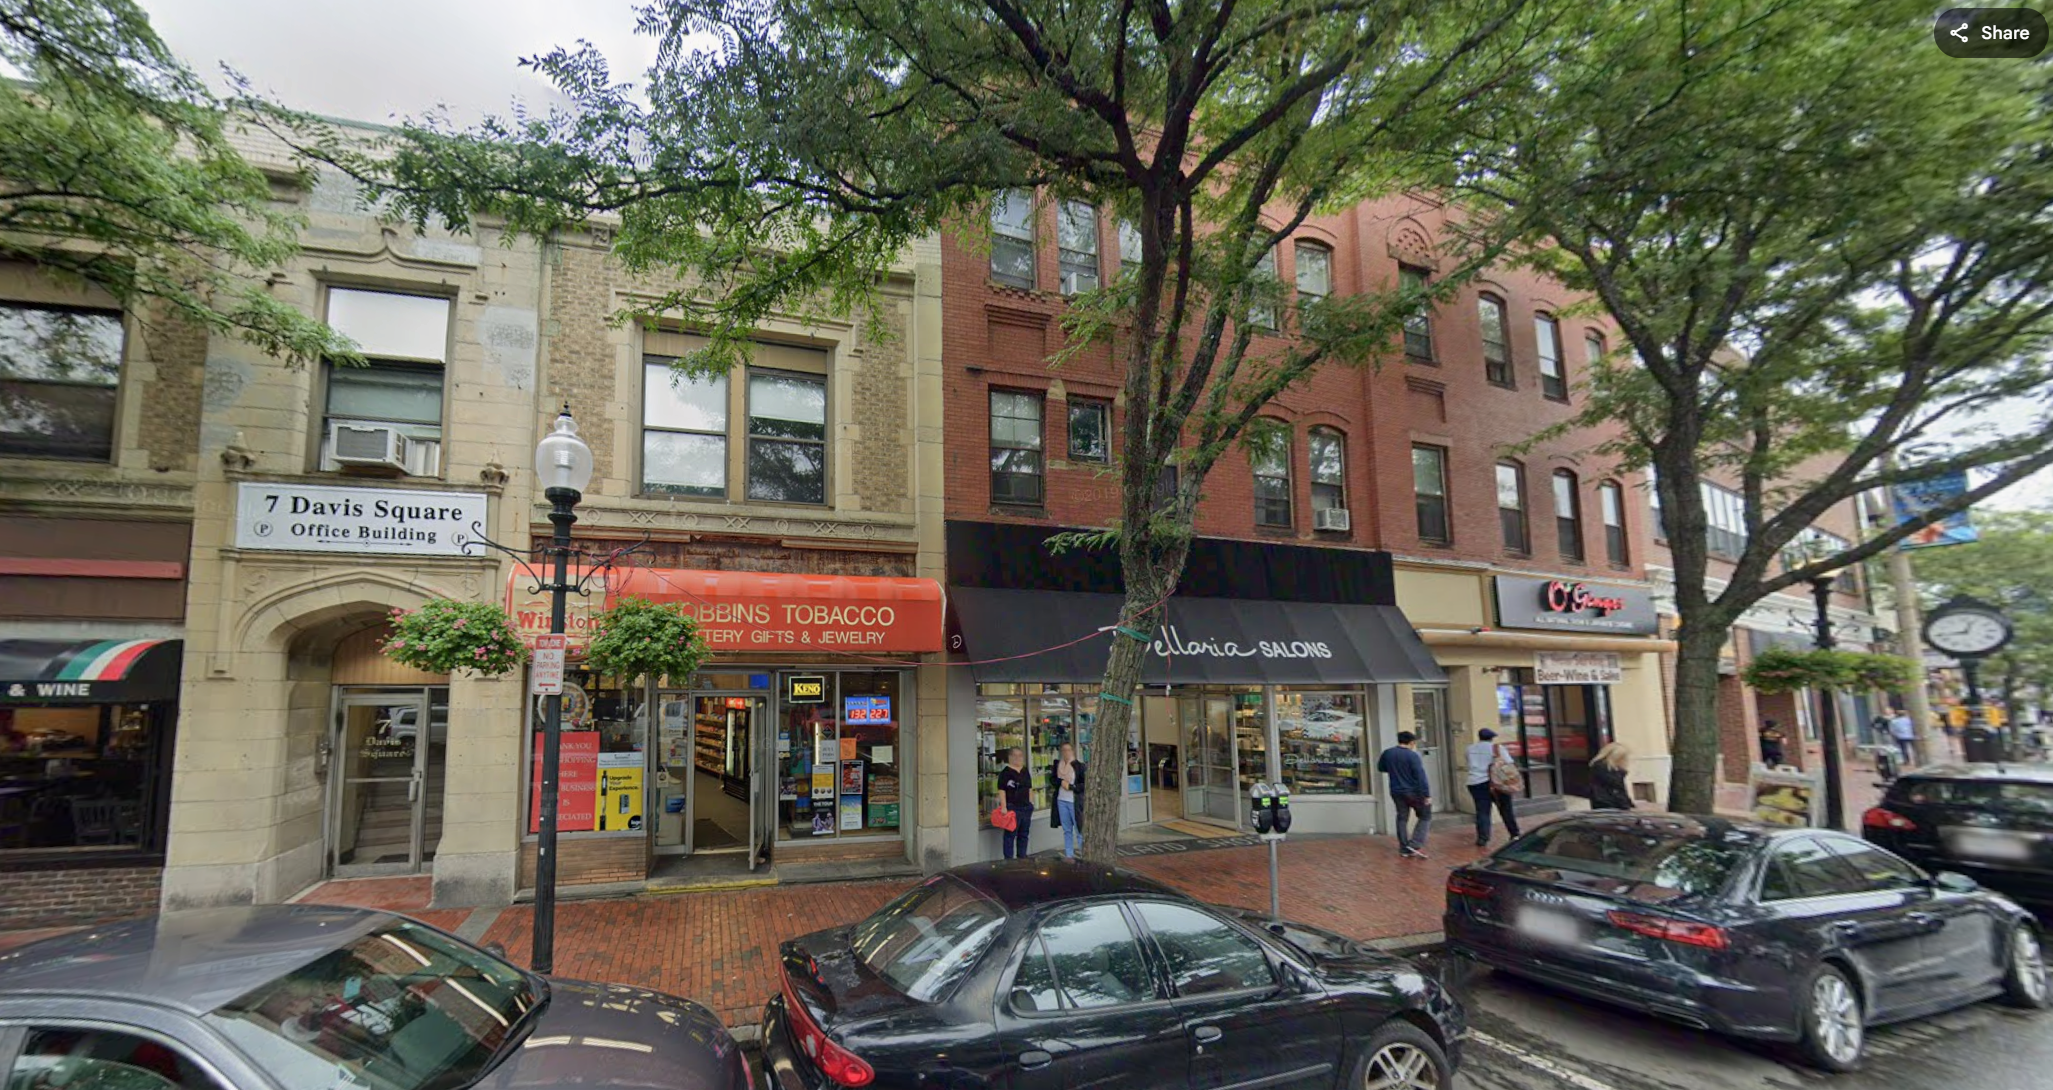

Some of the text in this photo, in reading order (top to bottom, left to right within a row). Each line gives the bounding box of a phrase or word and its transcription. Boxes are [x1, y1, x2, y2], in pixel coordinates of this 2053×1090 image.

[264, 494, 463, 523] 7 Davis Square
[291, 522, 437, 544] Office Building
[517, 610, 600, 629] Winton
[679, 602, 895, 626] OBBINS TOBACCO
[751, 629, 794, 643] GIFTS
[801, 631, 811, 644] &
[818, 631, 886, 644] JEWELRY
[1138, 625, 1333, 658] ellaria SALONS
[543, 652, 554, 660] NO
[536, 661, 560, 670] PARKING
[535, 670, 560, 679] ANYTIME
[1537, 668, 1589, 682] Beer-Wine
[8, 683, 91, 697] & WINE
[794, 683, 821, 695] KENO
[850, 708, 889, 719] 132 227
[376, 719, 392, 735] 7
[576, 742, 593, 750] YOU
[563, 799, 570, 807] IS
